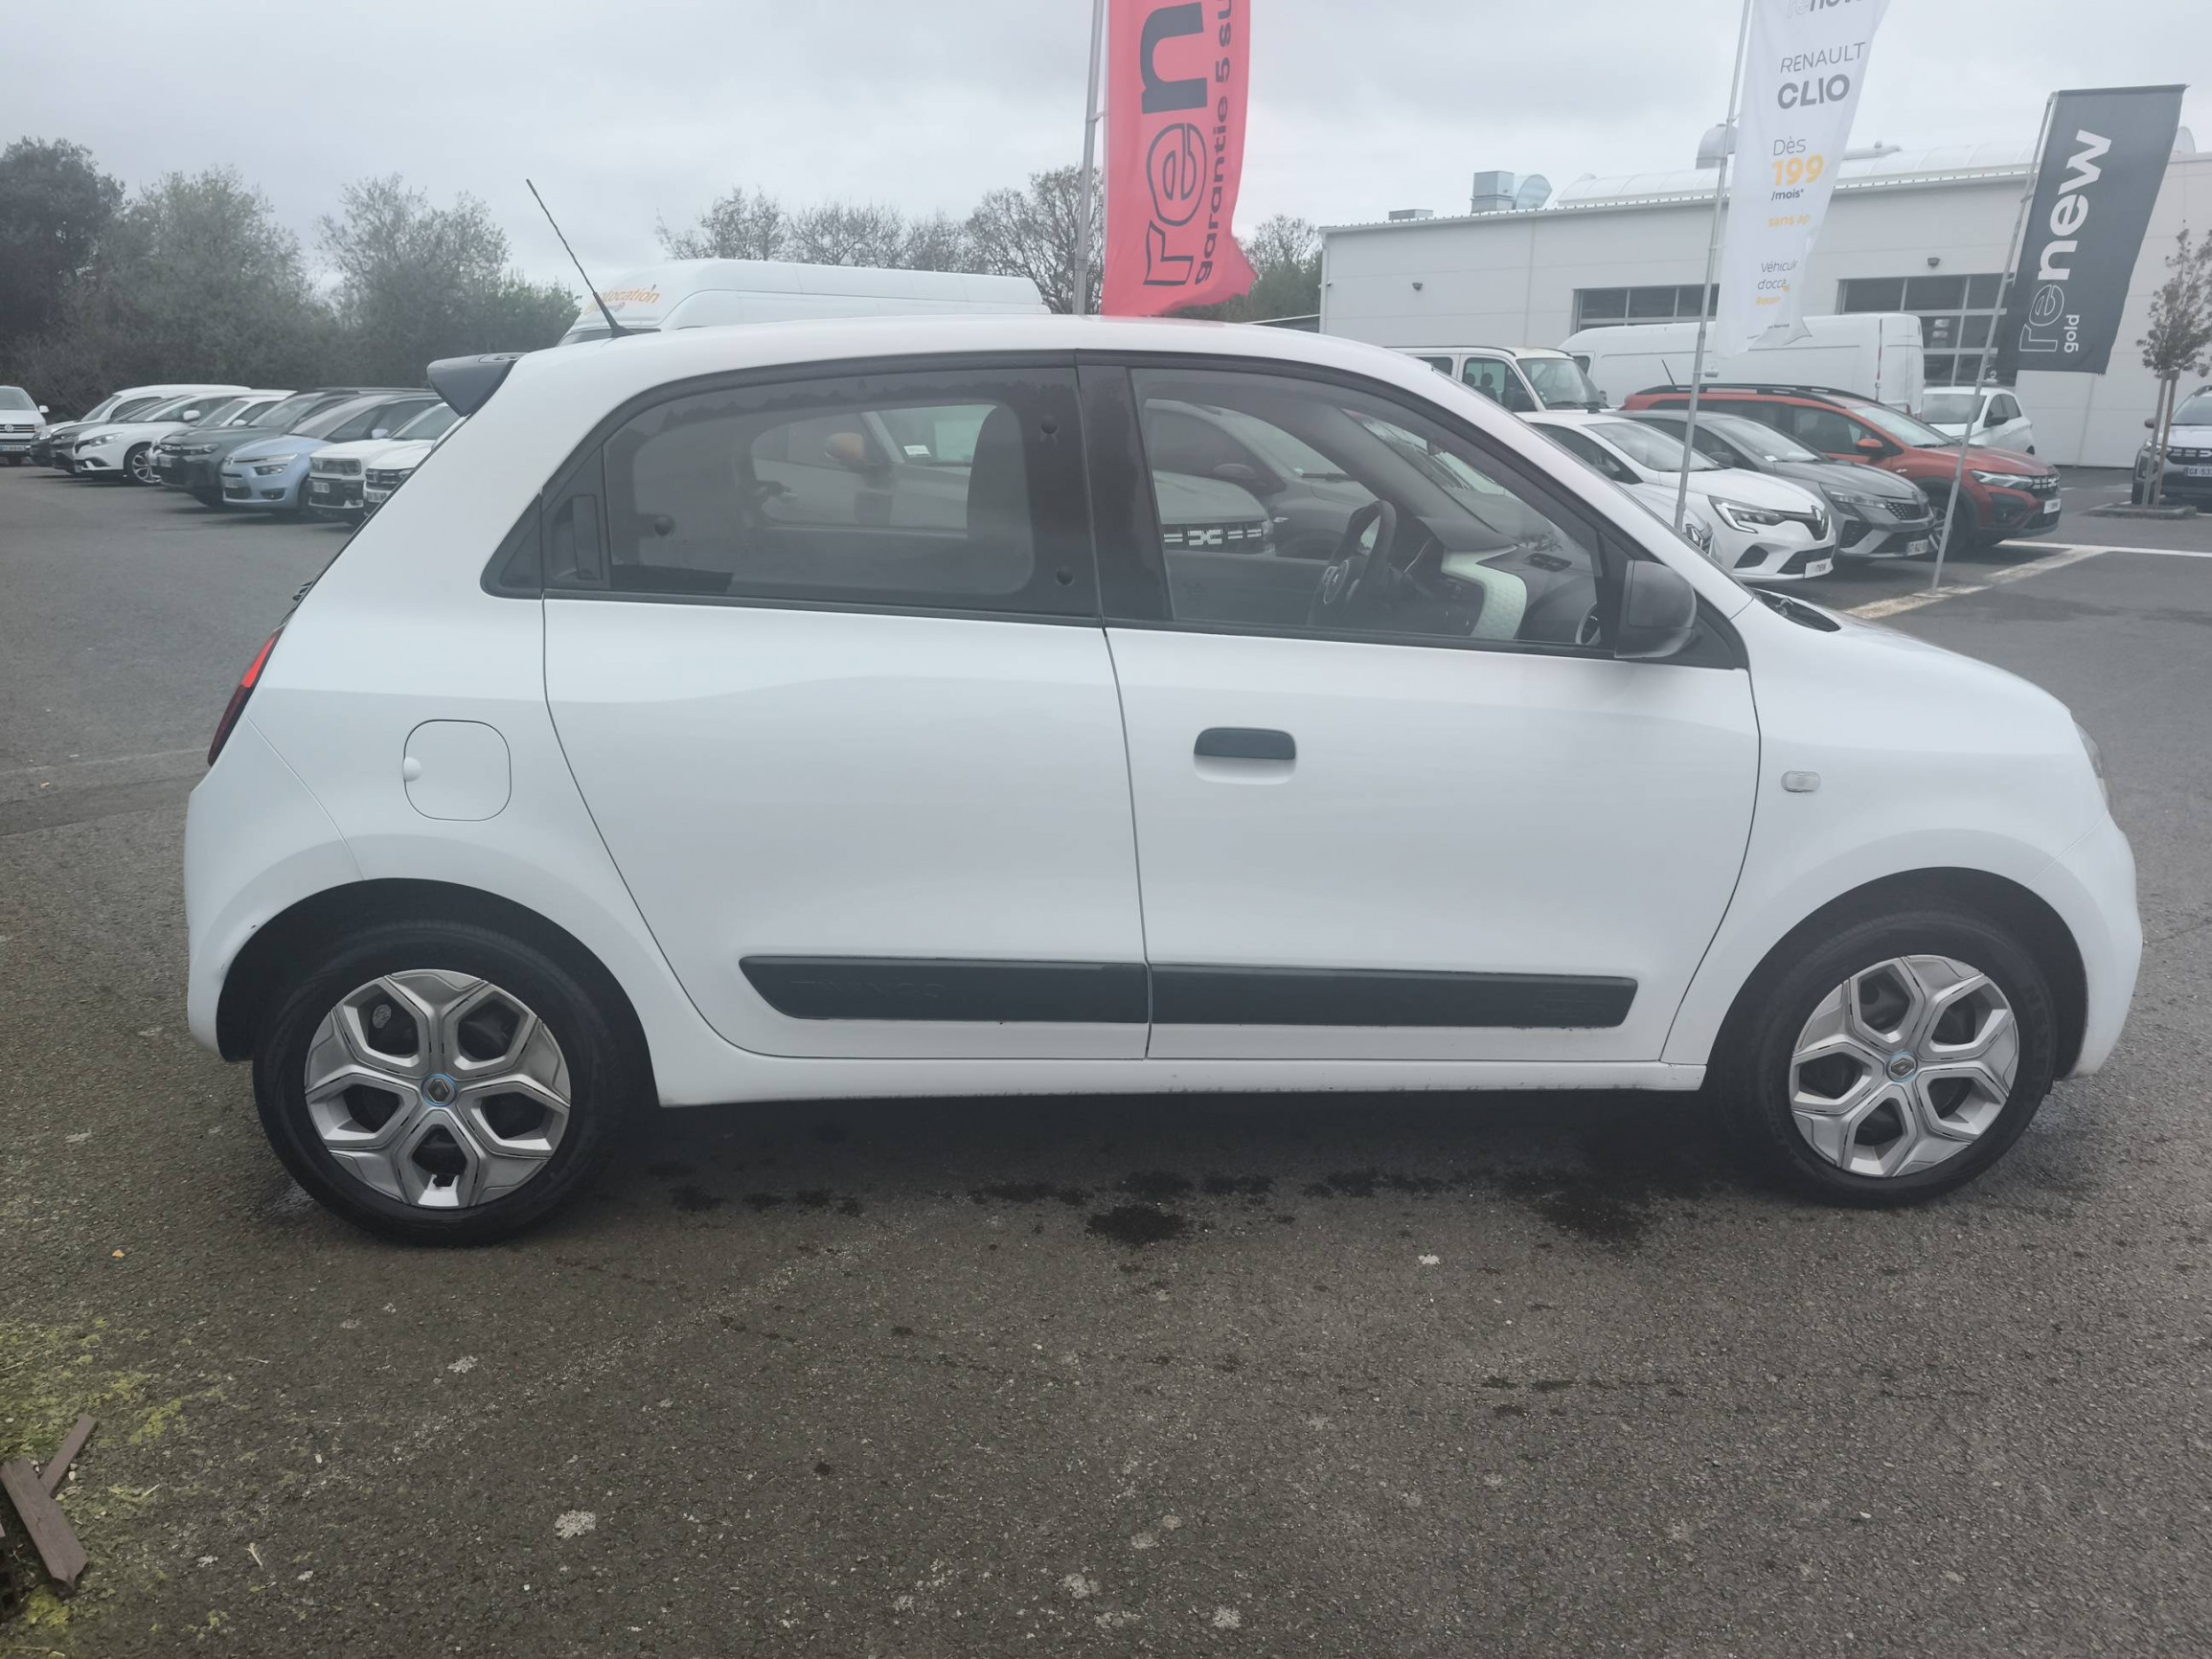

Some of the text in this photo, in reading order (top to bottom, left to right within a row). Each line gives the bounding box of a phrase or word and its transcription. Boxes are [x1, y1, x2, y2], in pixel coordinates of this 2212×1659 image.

[1780, 41, 1866, 74] RENAULT
[1777, 74, 1850, 109] CLIO
[1773, 136, 1807, 156] Dès
[1195, 96, 1228, 284] garantie
[1216, 57, 1231, 83] 5
[1771, 154, 1825, 187] 199
[2018, 129, 2112, 352] renew
[2064, 314, 2081, 352] gold
